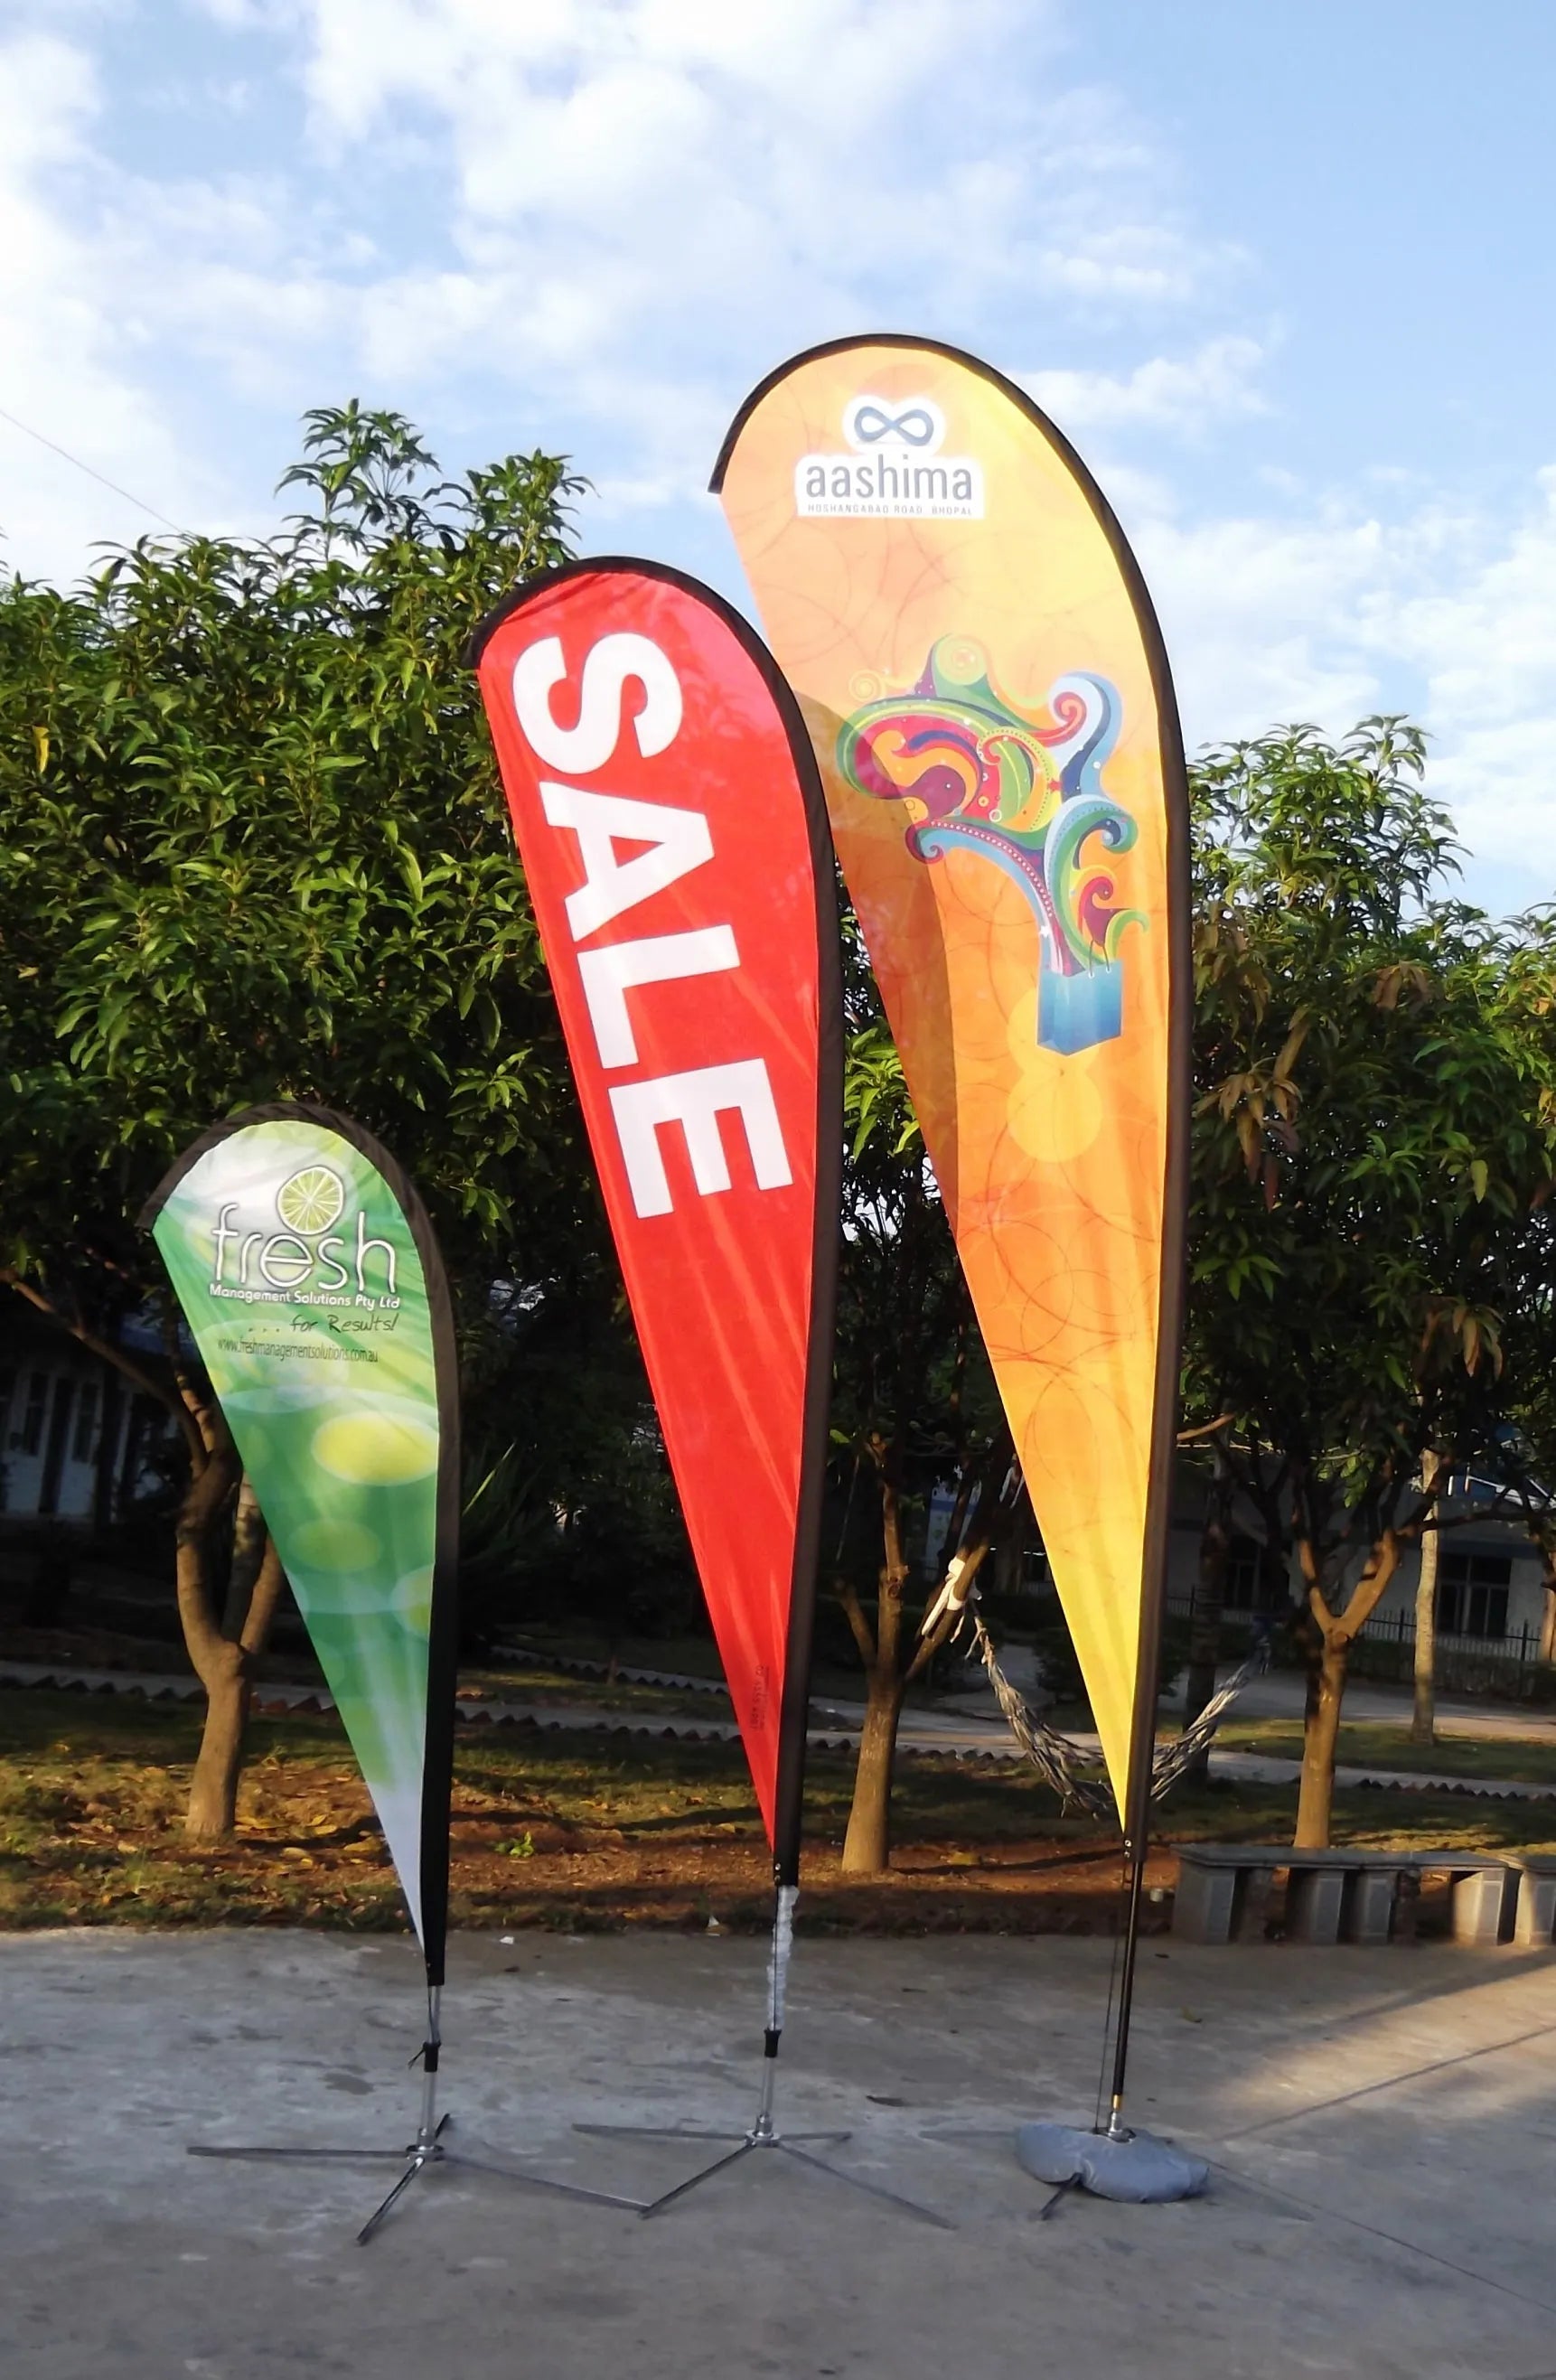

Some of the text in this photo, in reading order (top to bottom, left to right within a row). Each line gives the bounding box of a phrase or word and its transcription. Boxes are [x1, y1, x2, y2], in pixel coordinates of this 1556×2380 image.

[806, 454, 972, 501] aashima
[807, 503, 972, 516] HOSHANGABAD ROAD BHOPAL
[511, 632, 794, 1219] SALE
[211, 1202, 398, 1294] fresh
[210, 1284, 401, 1311] Management Solutions Pty Ltd
[289, 1315, 318, 1332] for
[327, 1311, 399, 1334] Results!
[217, 1337, 379, 1363] www.freshmanagementsolutions.com.au
